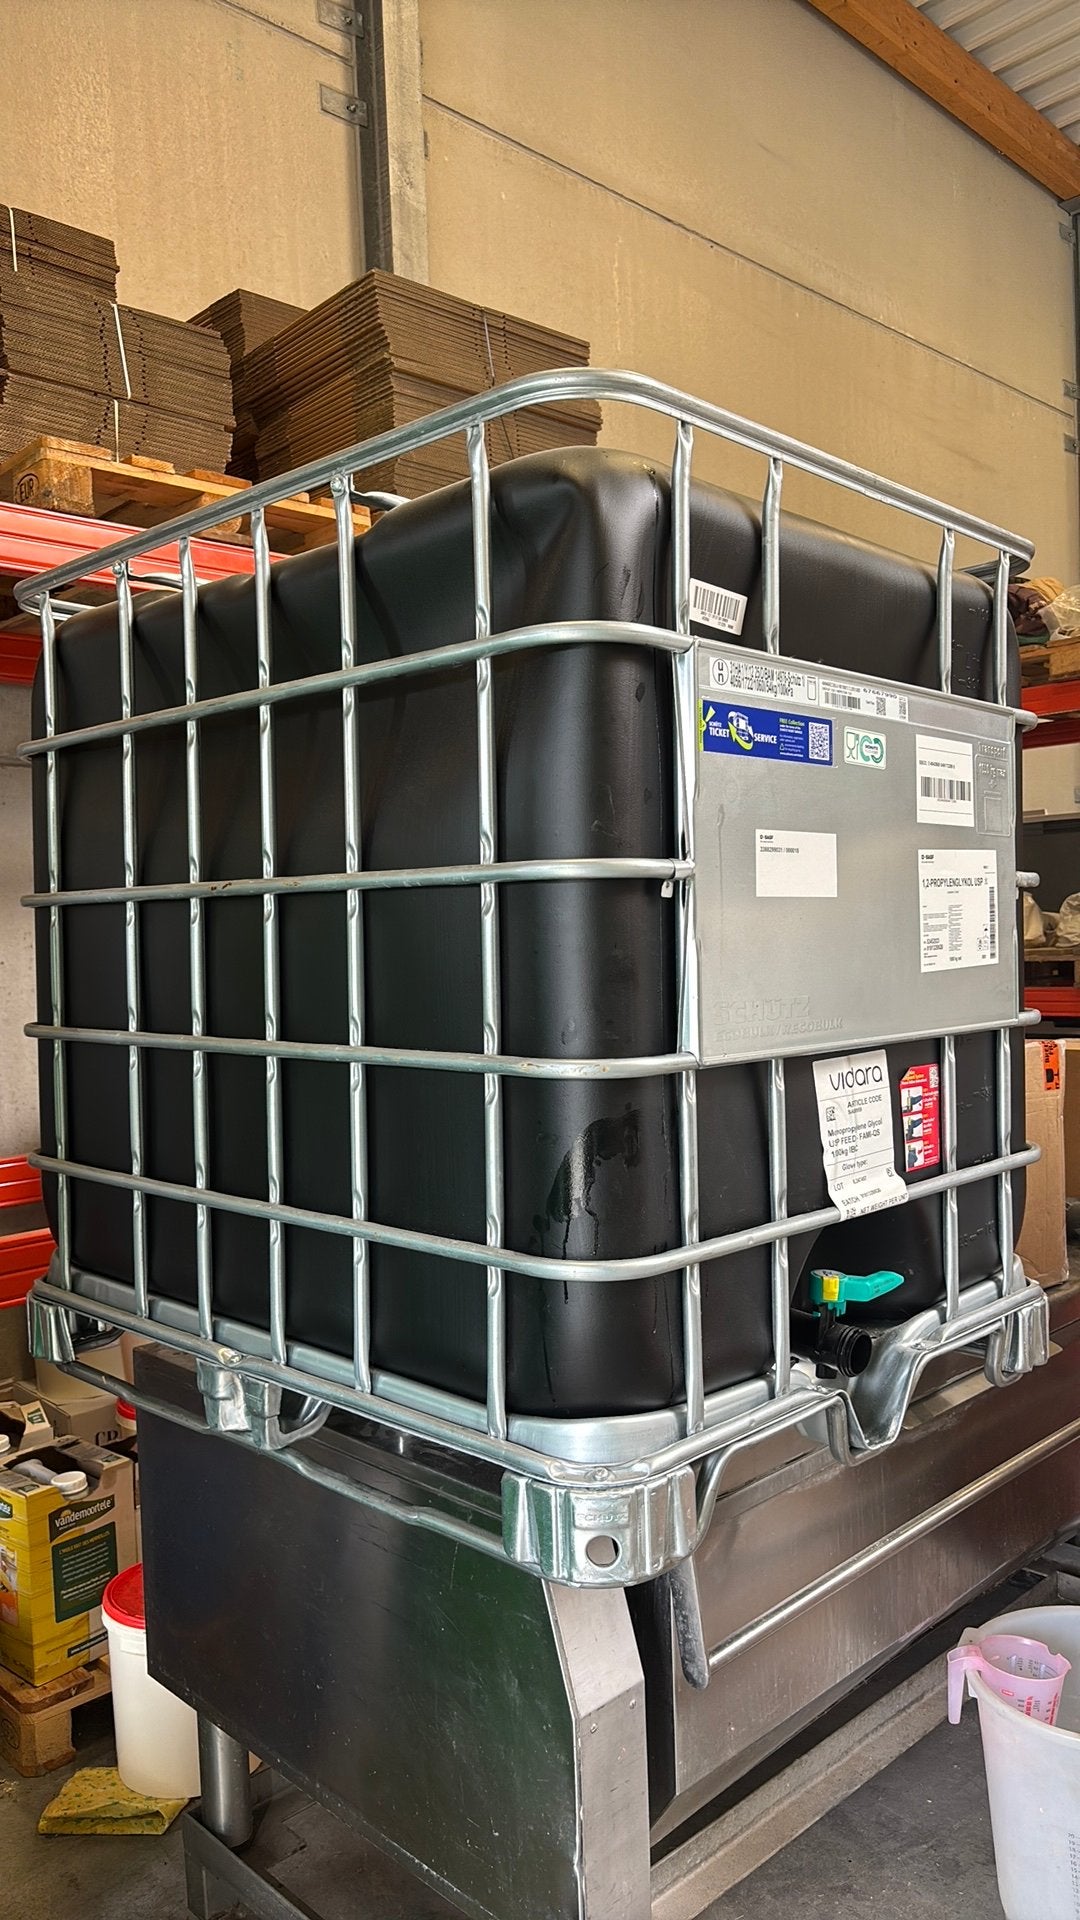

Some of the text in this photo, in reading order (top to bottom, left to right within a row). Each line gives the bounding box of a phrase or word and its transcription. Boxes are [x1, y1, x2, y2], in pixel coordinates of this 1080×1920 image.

[709, 727, 730, 738] TICKET
[753, 733, 777, 744] SERVICE
[974, 877, 984, 887] USP
[828, 1065, 884, 1091] vidara
[847, 1094, 883, 1108] ARTICLE CODE
[866, 1117, 883, 1131] Glycol
[833, 1182, 844, 1191] LOT
[55, 1499, 111, 1528] vandemoortele
